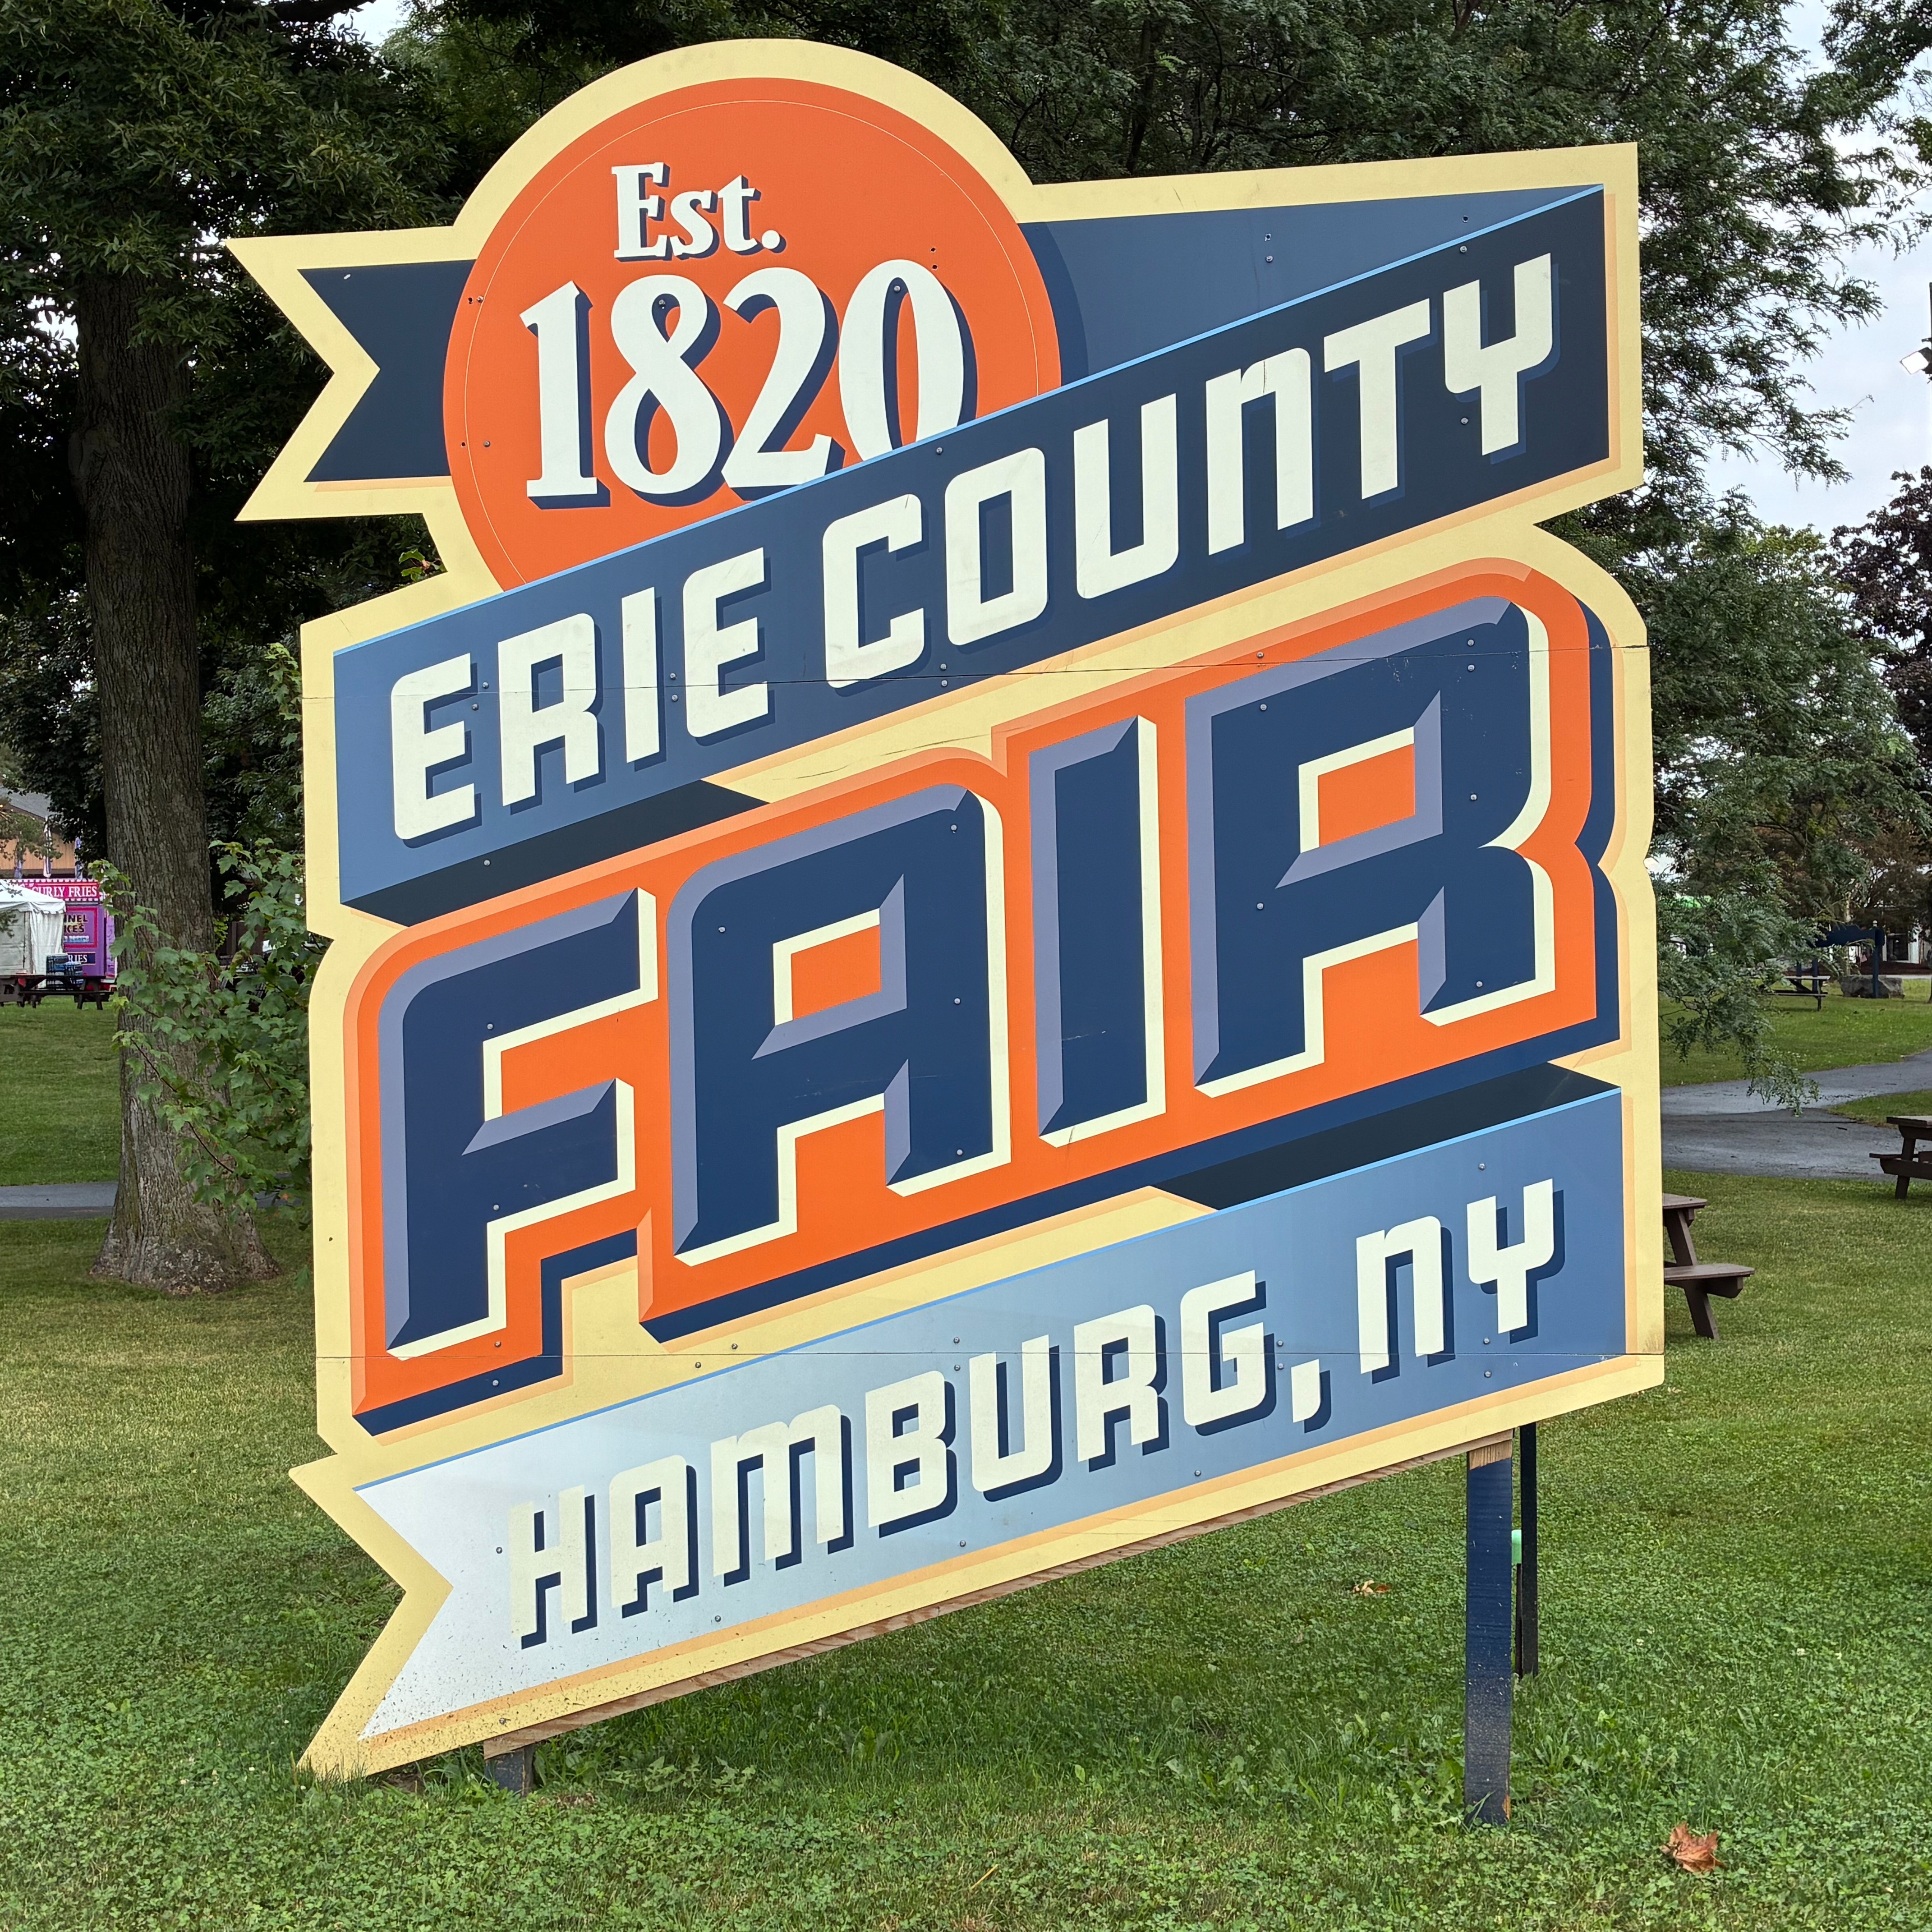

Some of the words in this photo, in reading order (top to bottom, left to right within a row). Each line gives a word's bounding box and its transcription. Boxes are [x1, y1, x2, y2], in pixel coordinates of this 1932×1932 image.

[612, 161, 781, 259] Est.
[519, 258, 965, 498] 1820
[391, 547, 770, 840] ERIE
[823, 253, 1554, 688] COUNTY
[64, 914, 88, 922] NEL
[68, 954, 87, 963] RIES
[69, 886, 97, 897] FRIES
[378, 596, 1555, 1359] FAIR
[509, 1270, 1321, 1638] HAMBURG,
[1356, 1178, 1555, 1375] NY
